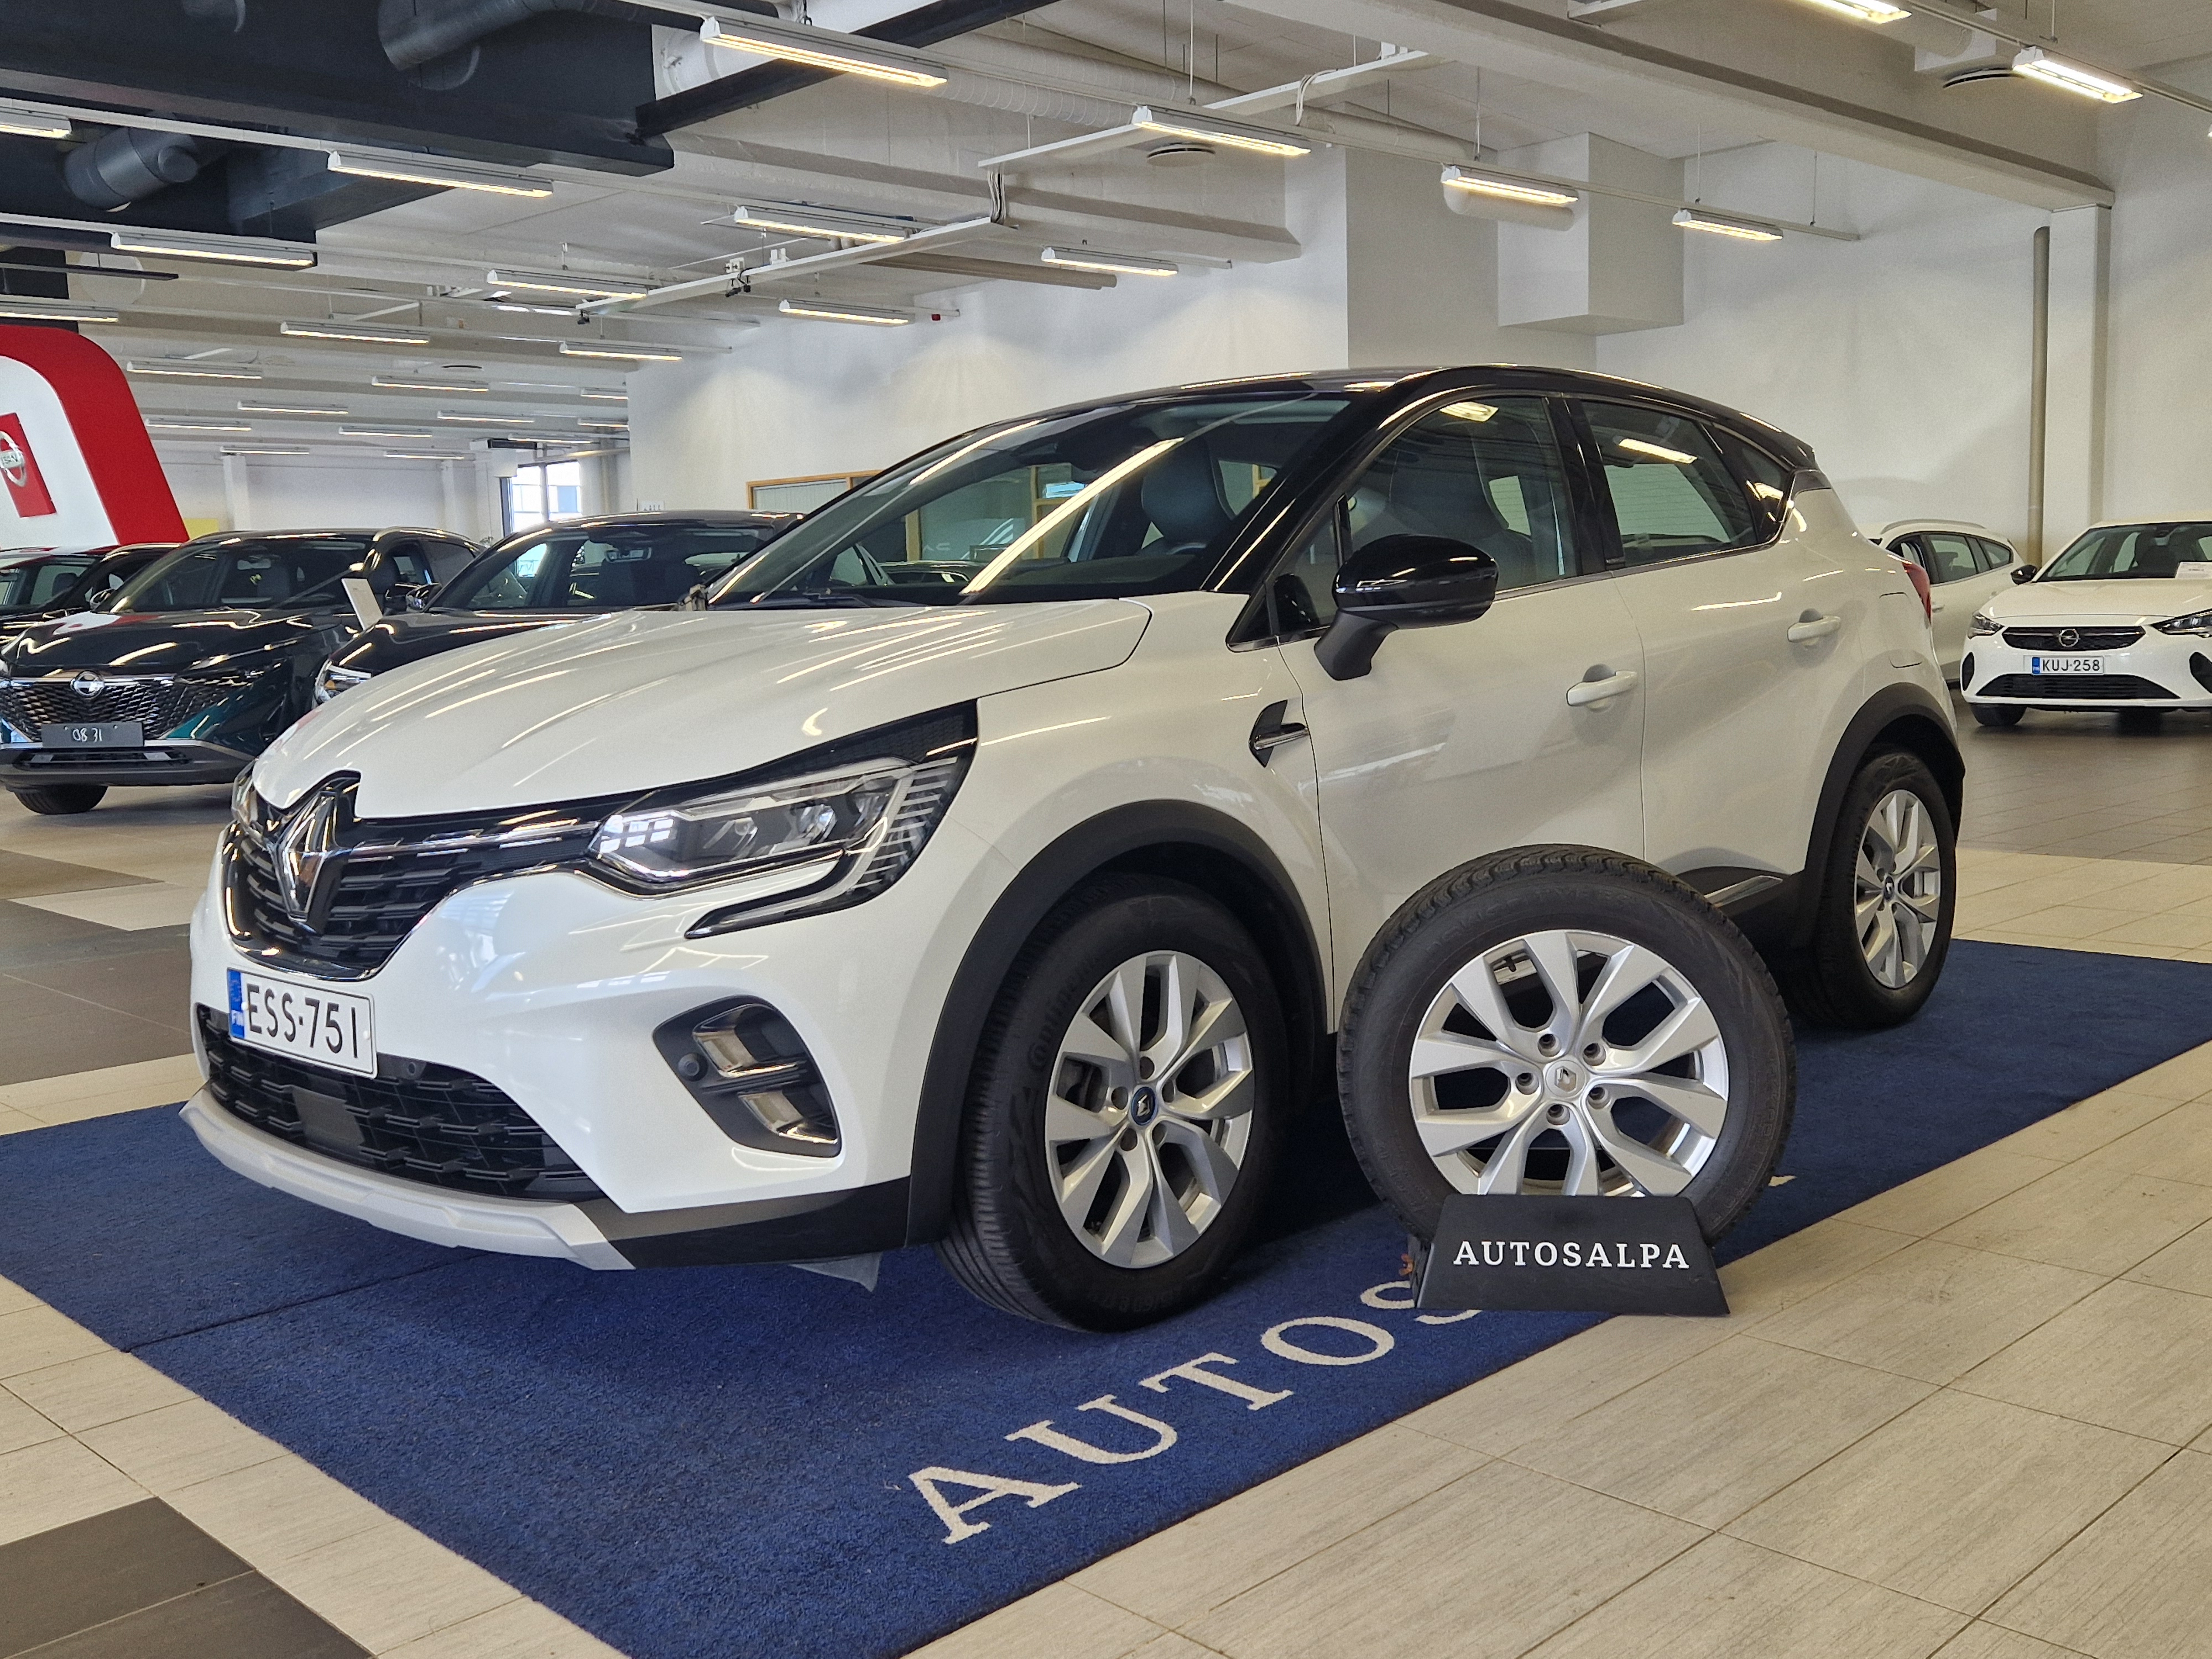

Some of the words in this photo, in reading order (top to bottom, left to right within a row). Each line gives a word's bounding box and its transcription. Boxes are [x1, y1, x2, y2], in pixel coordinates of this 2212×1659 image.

[2042, 659, 2100, 672] KUJ-258
[230, 1009, 244, 1026] FIN
[247, 983, 358, 1058] ESS-751
[1452, 1240, 1690, 1270] AUTOSALPA
[909, 1280, 1482, 1546] AUTOS
